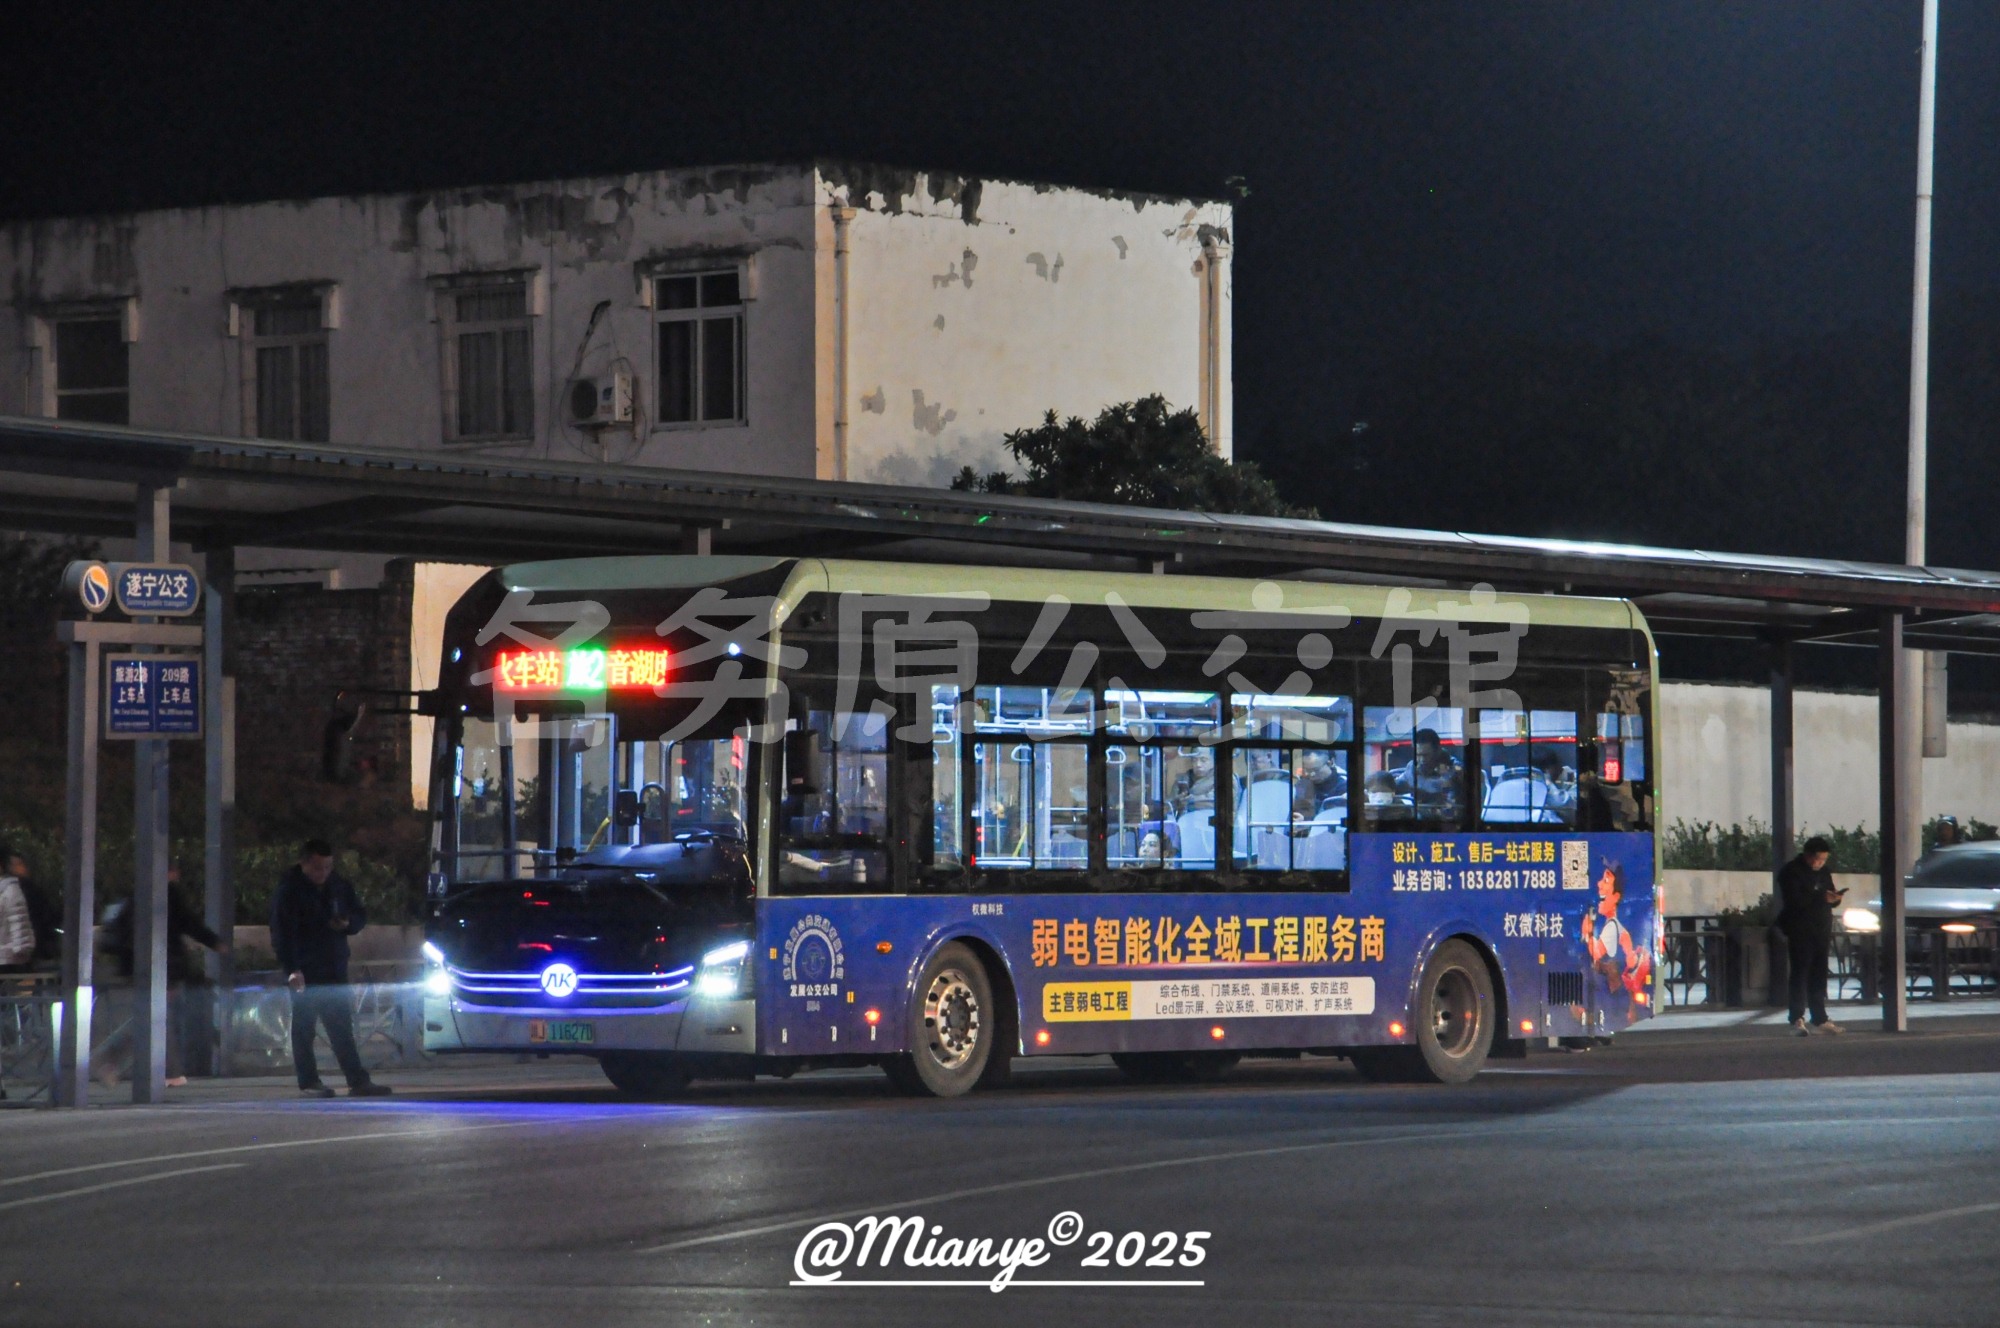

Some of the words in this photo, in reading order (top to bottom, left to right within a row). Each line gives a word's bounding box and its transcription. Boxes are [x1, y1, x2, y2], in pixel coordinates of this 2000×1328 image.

[126, 573, 188, 598] 遂宁公交
[161, 667, 190, 683] 209路
[117, 687, 146, 704] 上车点
[160, 687, 192, 704] 上车点
[1393, 842, 1555, 863] 设计、施工、售后一站式服务
[972, 903, 1004, 916] 权微科技
[1503, 912, 1564, 938] 权微科技
[1031, 914, 1385, 967] 弱电智能化全域工程服务商
[790, 983, 838, 997] 发展公交公司
[1050, 990, 1129, 1014] 主营弱电工程
